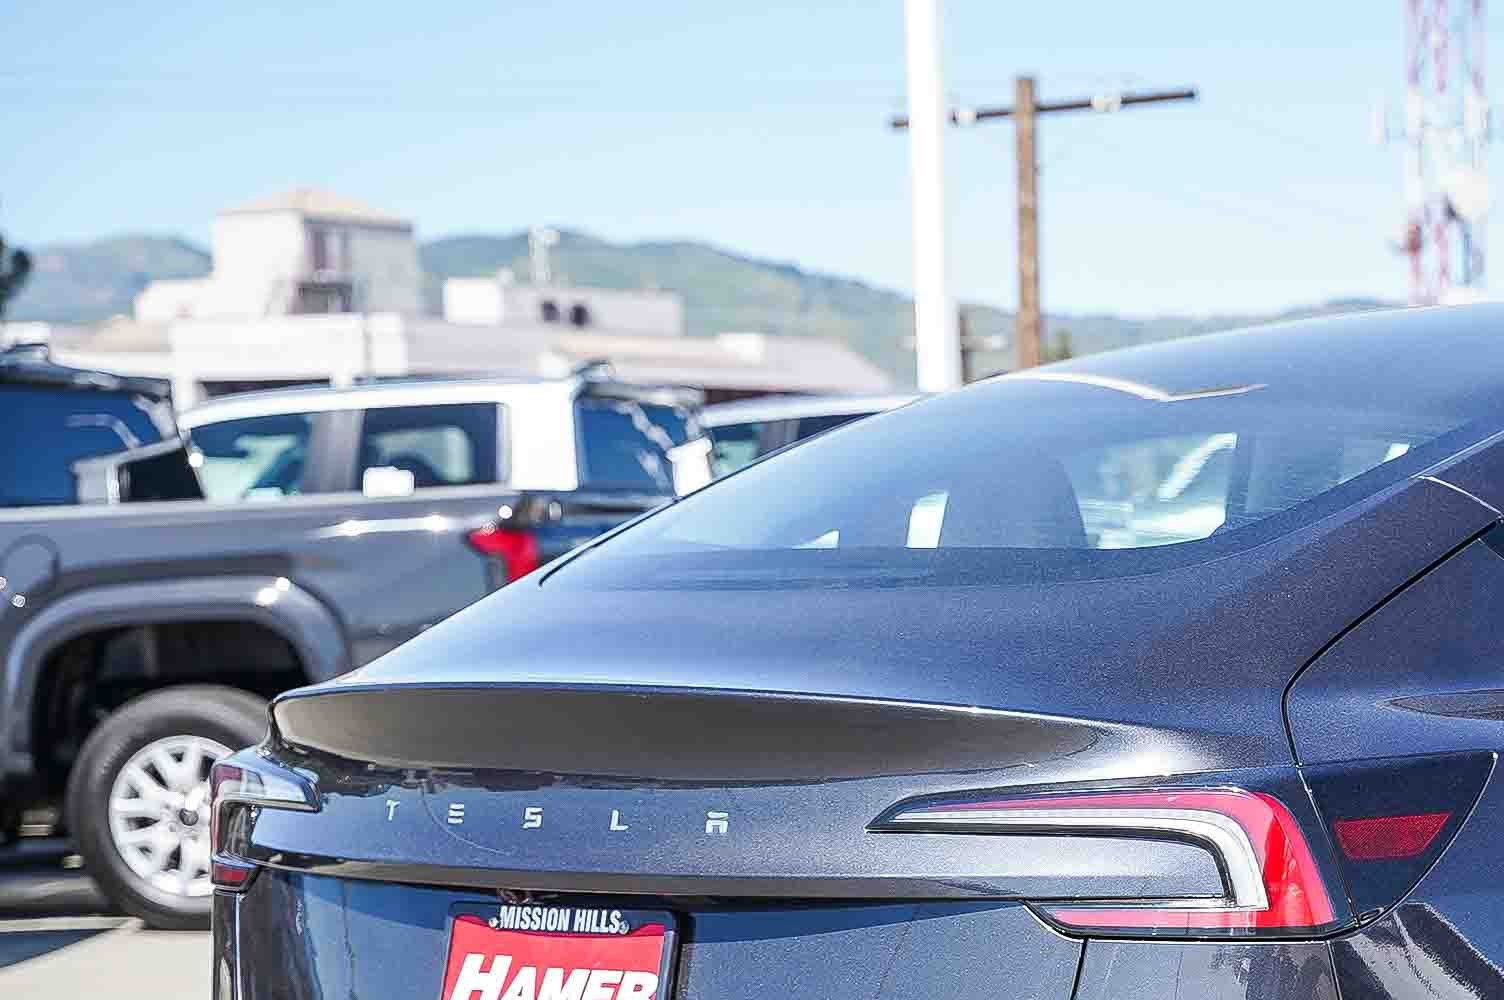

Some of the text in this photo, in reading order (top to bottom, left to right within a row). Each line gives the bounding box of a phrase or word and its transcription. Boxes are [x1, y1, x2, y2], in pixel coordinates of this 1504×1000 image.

[386, 799, 729, 834] TESLA
[499, 905, 622, 933] MISSION HILLS
